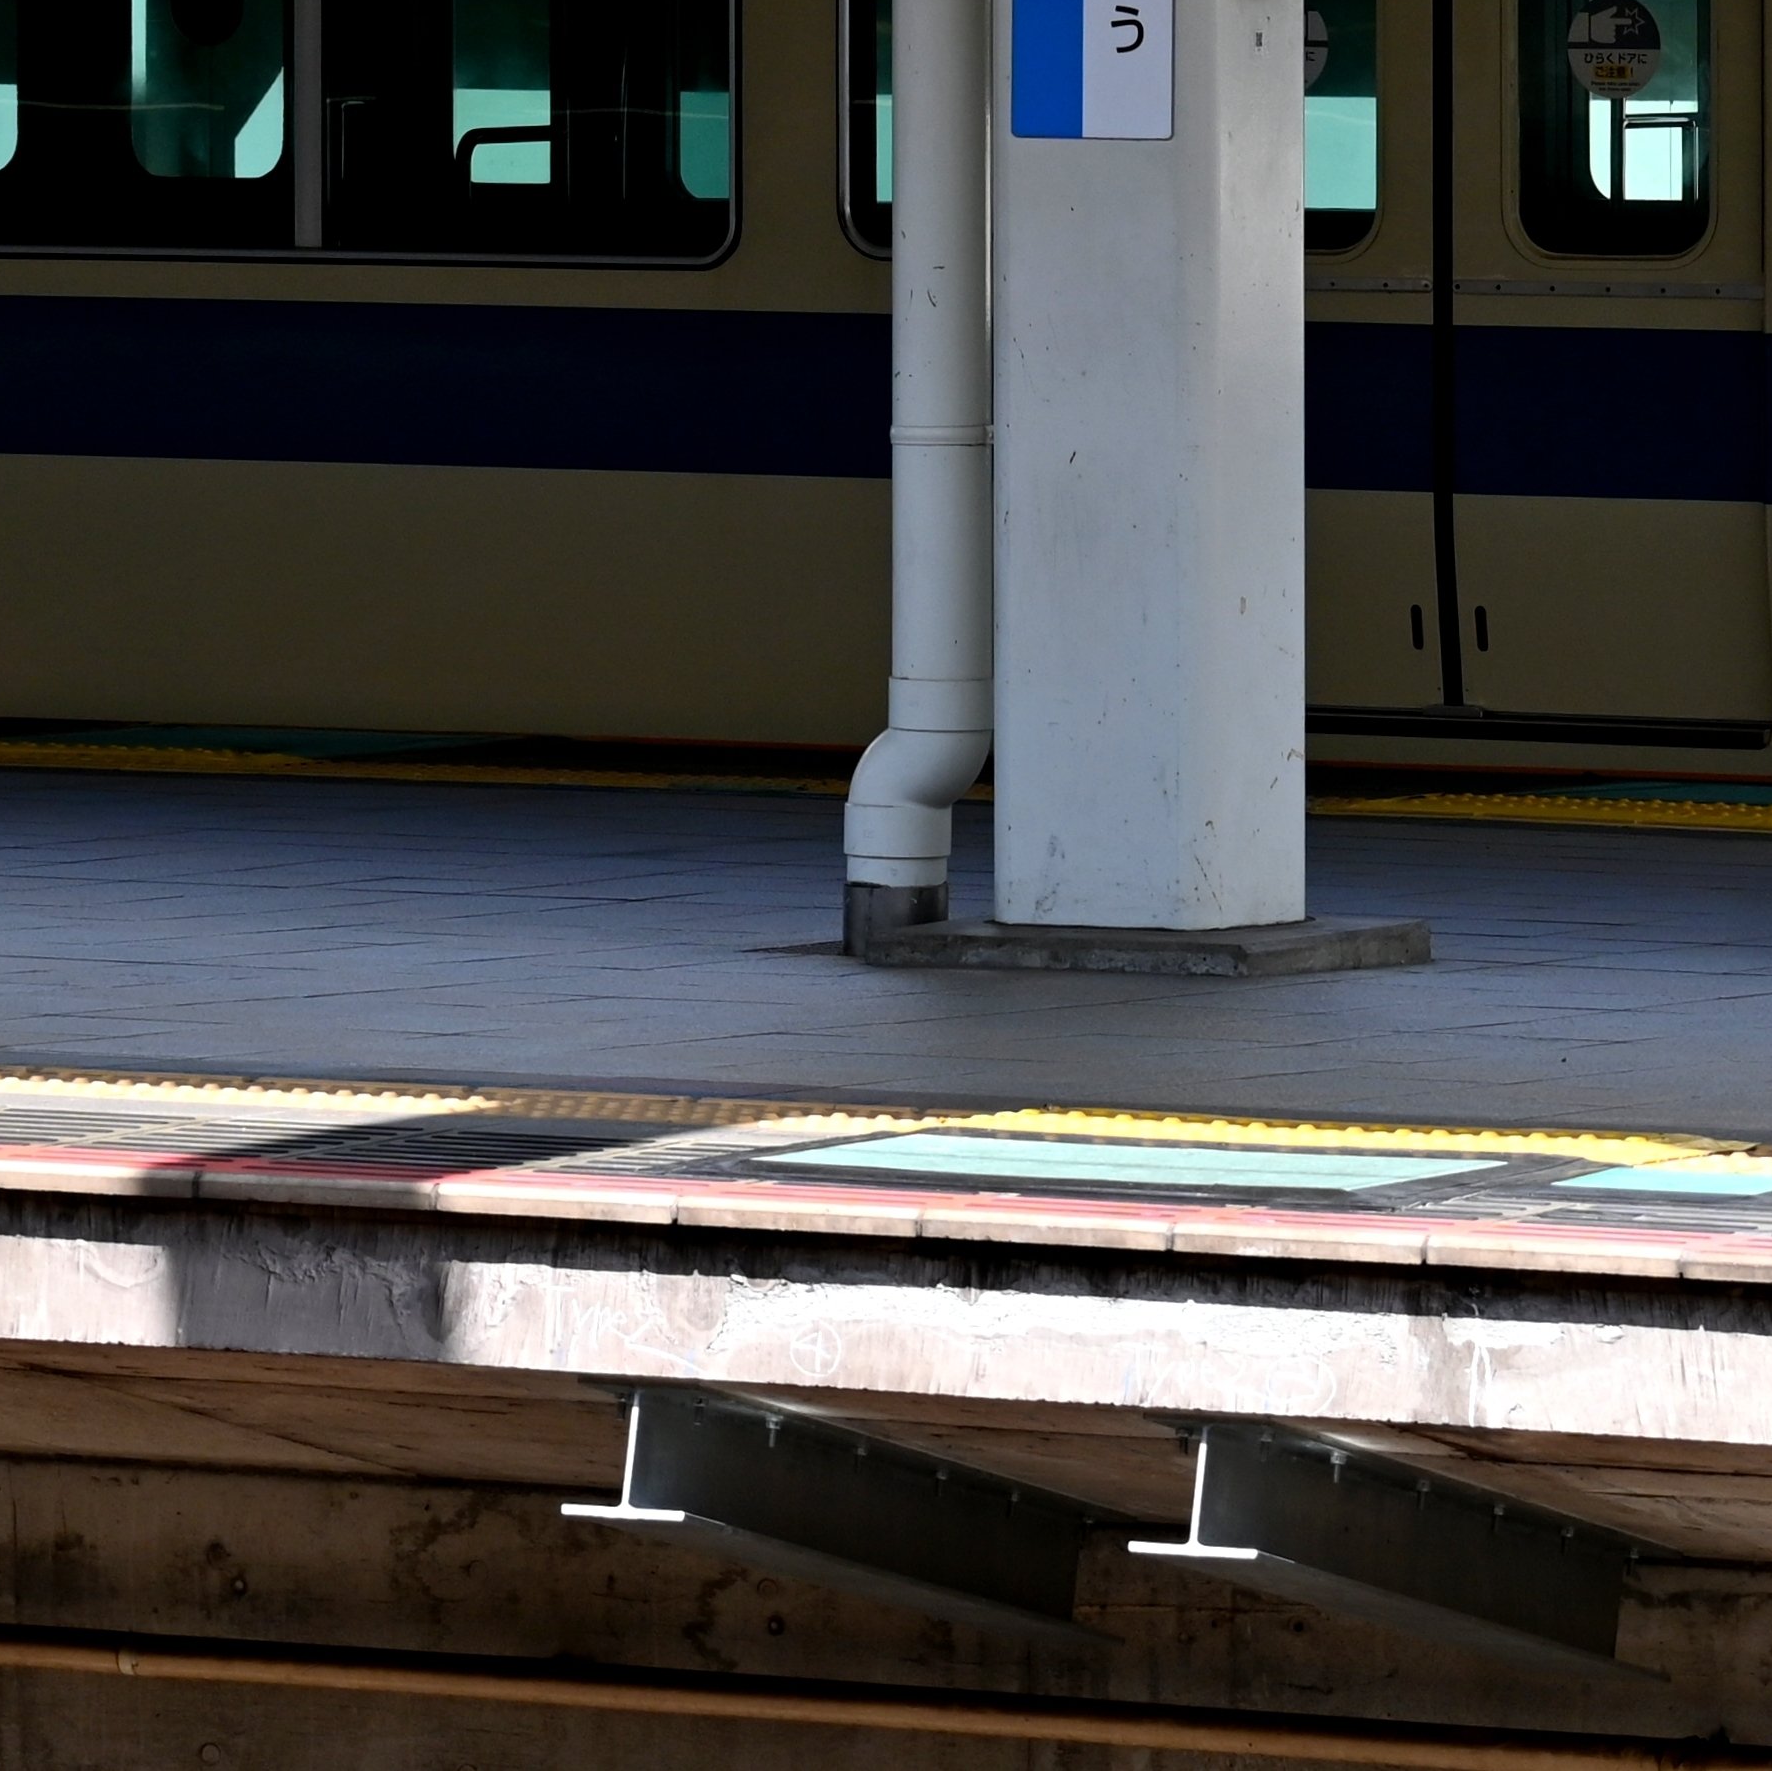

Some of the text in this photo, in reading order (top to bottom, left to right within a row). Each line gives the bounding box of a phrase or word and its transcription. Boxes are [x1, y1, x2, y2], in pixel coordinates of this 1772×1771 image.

[1584, 52, 1648, 64] ひらくドアに
